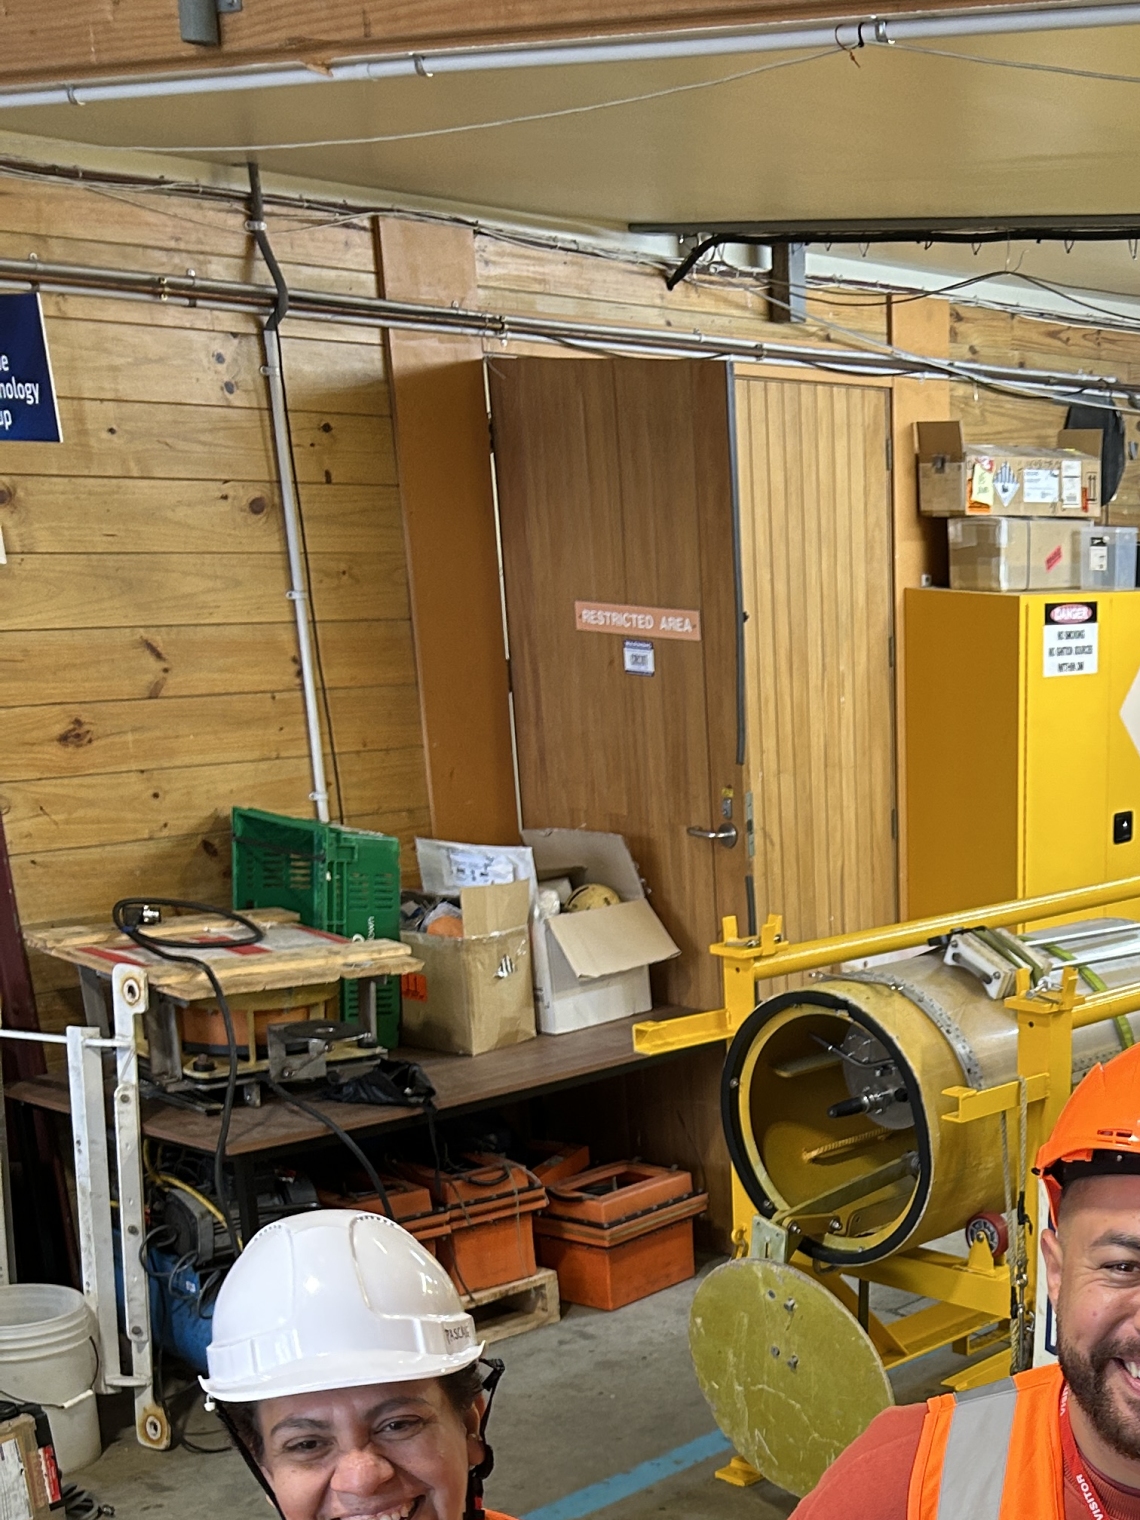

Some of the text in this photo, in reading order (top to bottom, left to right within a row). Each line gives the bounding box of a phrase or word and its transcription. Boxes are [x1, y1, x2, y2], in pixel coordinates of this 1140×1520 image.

[0, 376, 40, 406] nology
[581, 609, 693, 633] RESTRICTED AREA
